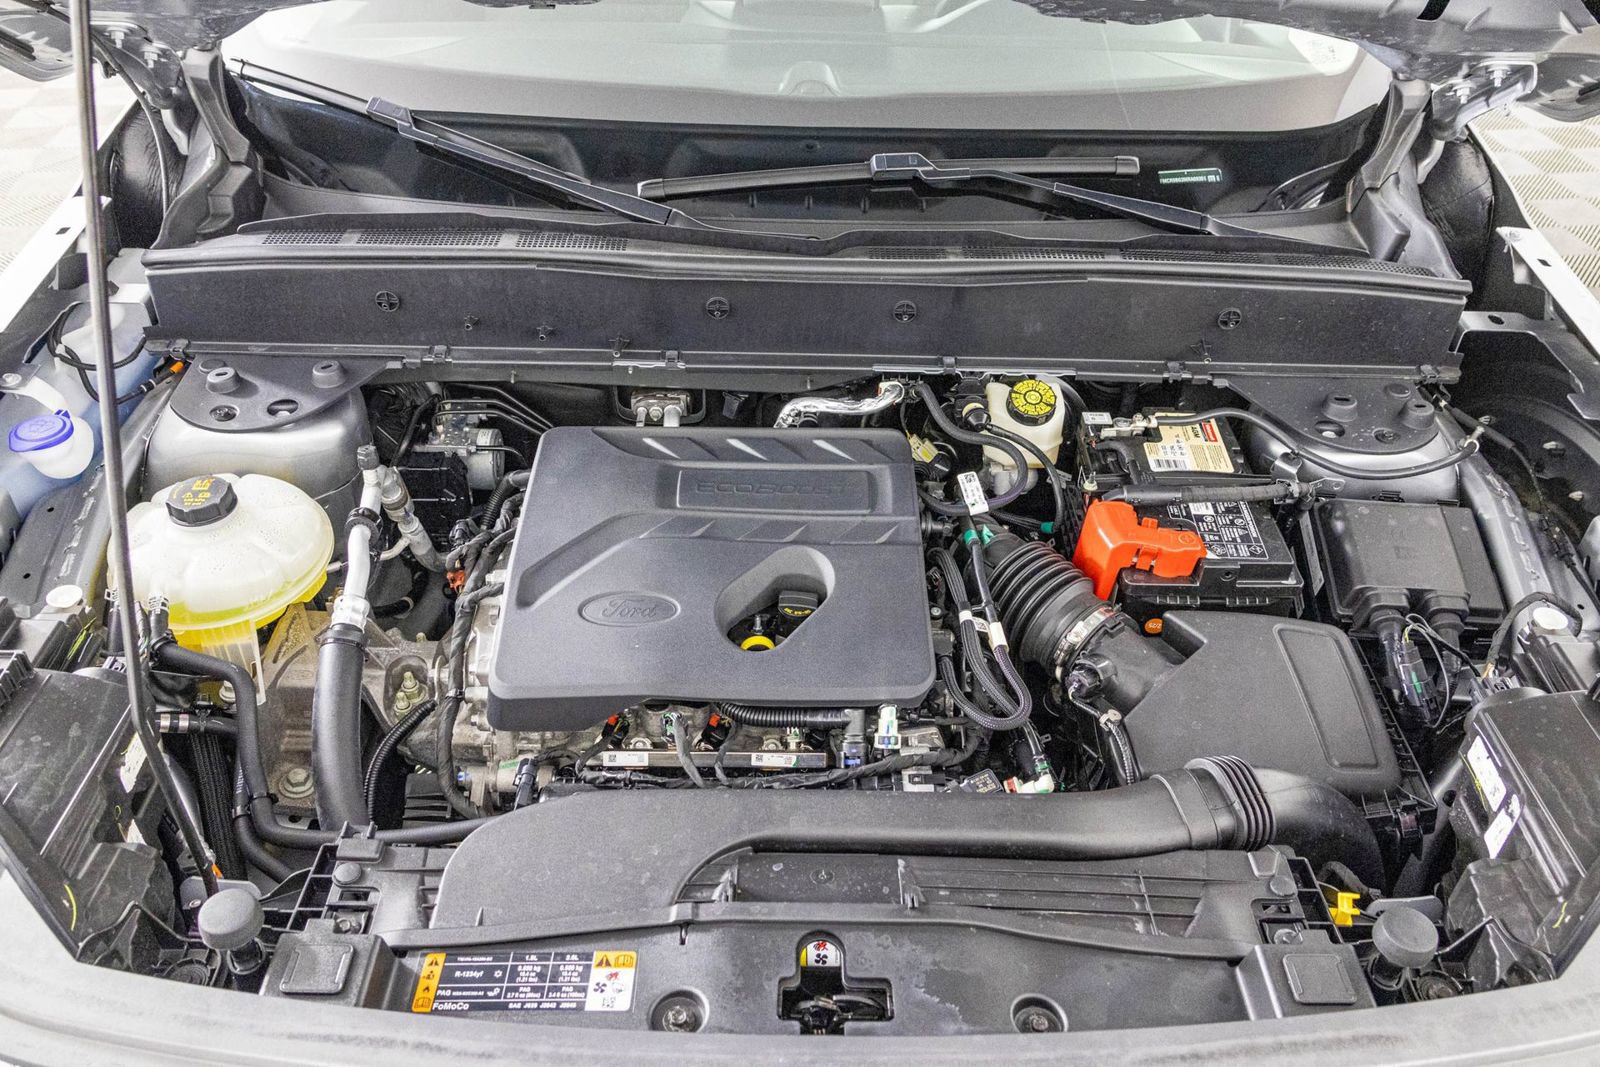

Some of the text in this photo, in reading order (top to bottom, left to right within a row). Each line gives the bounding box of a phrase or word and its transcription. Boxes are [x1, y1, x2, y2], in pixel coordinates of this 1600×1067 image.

[601, 599, 658, 618] Ford
[454, 970, 484, 978] R-1234yf
[432, 1002, 469, 1010] FoMoCo
